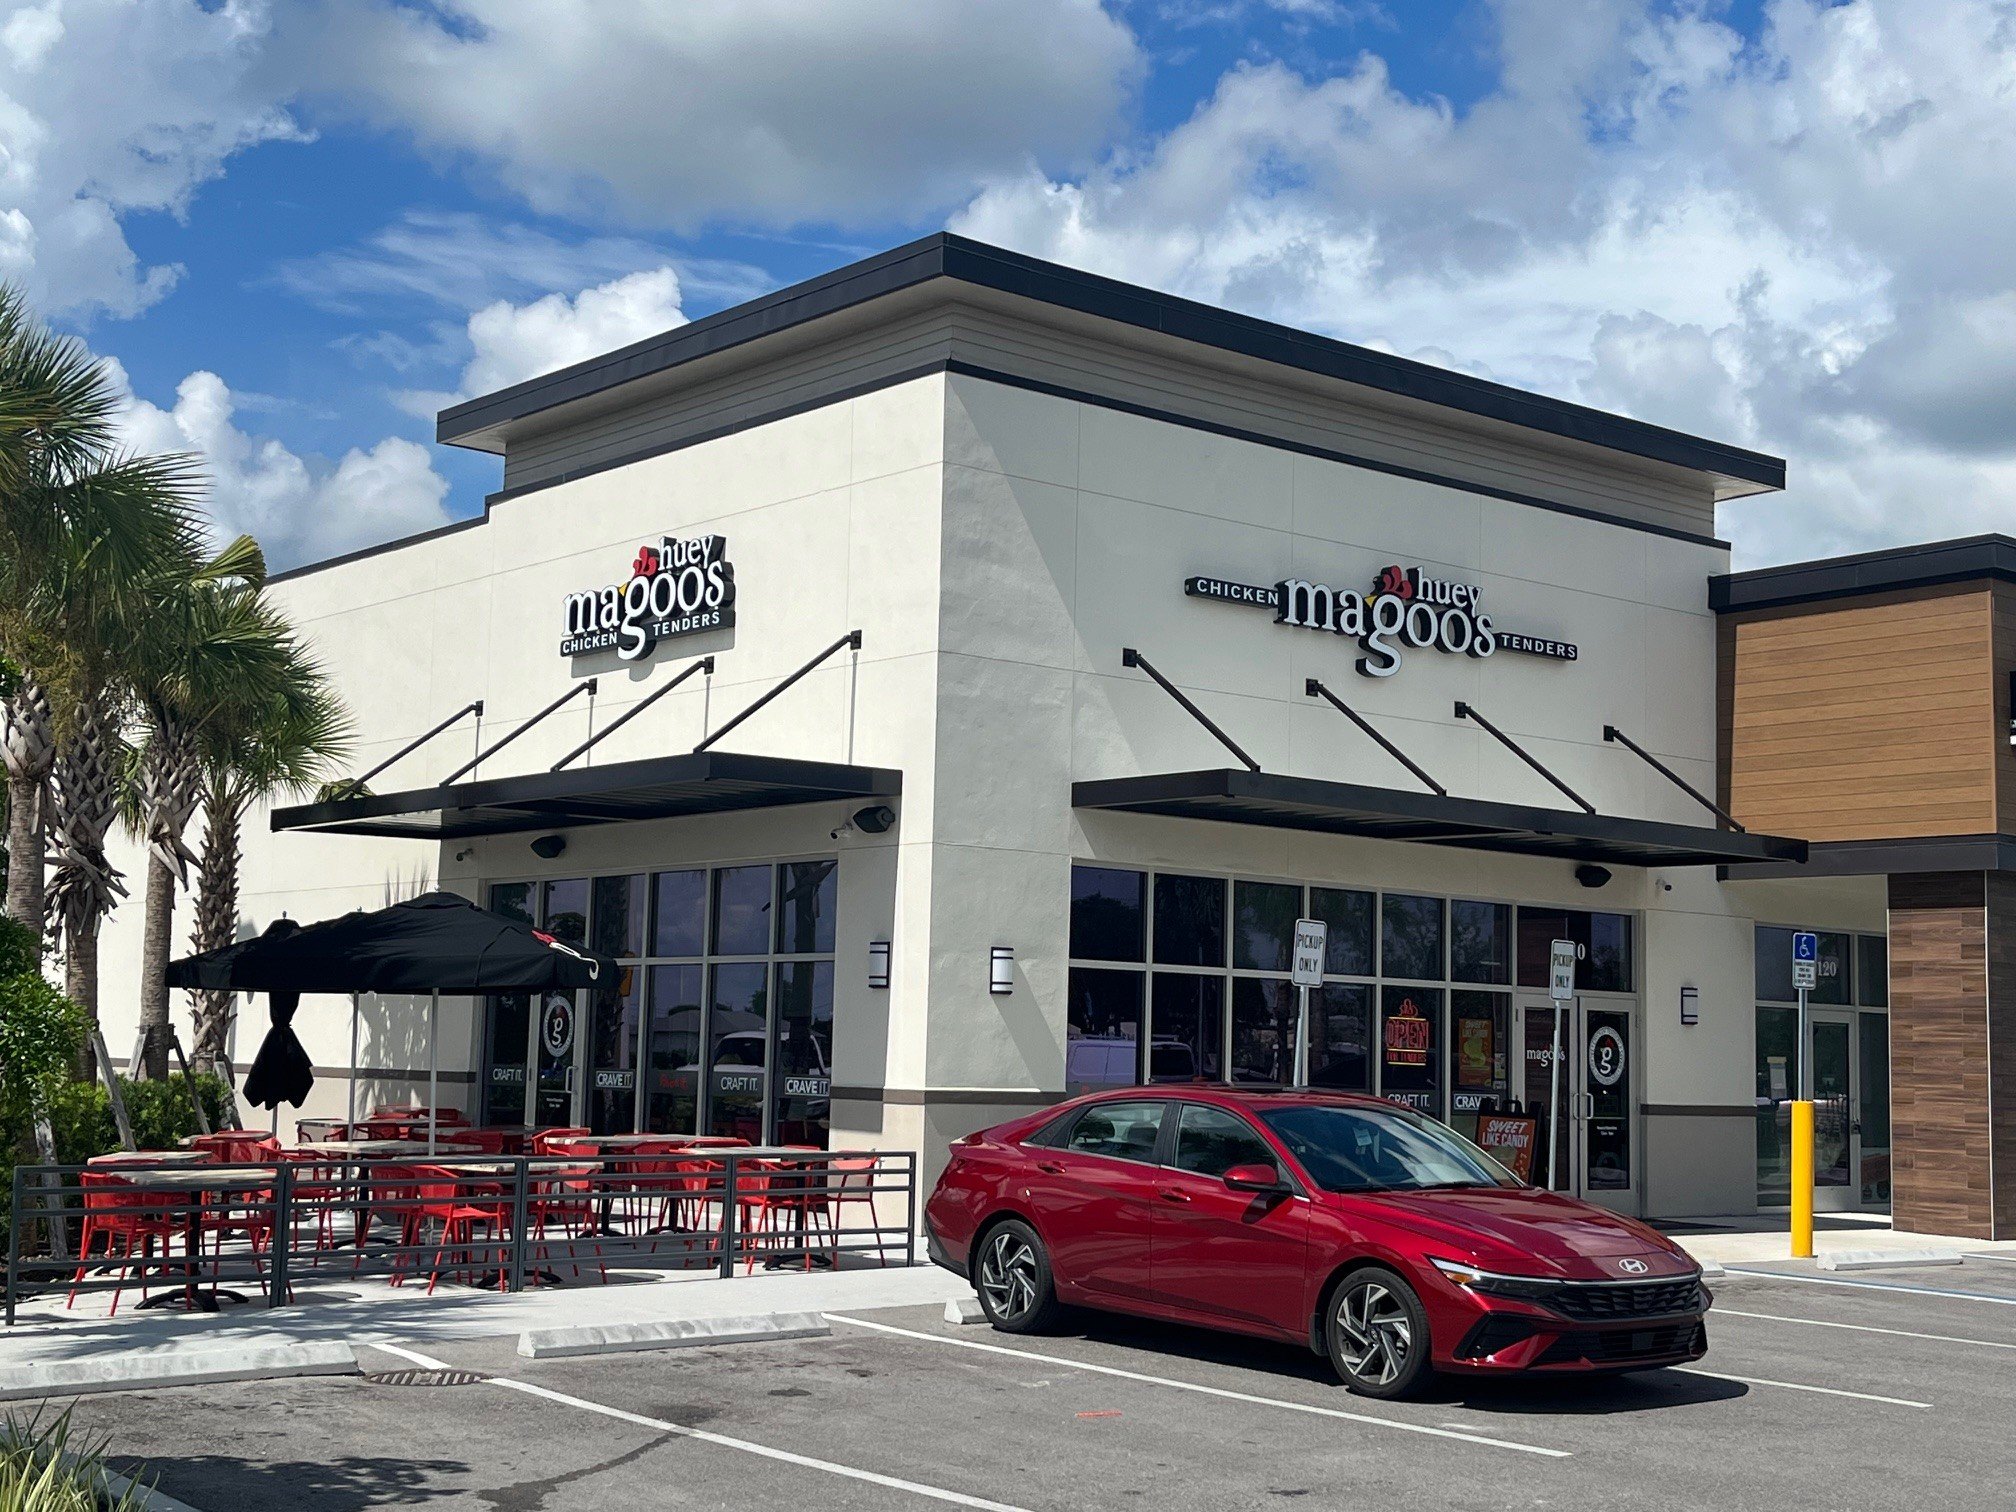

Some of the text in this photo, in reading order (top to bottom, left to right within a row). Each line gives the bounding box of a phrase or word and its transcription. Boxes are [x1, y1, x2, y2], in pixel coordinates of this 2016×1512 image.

[658, 534, 715, 569] huey
[1196, 579, 1279, 605] CHICKEN
[1416, 566, 1483, 618] huey
[653, 611, 721, 636] TENDERS
[563, 632, 618, 654] CHICKEN
[1501, 634, 1576, 659] TENDERS
[1297, 933, 1324, 949] PICKUP
[1299, 957, 1318, 972] ONLY
[1553, 953, 1573, 967] PICKUP
[1818, 961, 1837, 977] 120
[1555, 974, 1570, 988] ONLY
[1386, 1019, 1429, 1049] OPEN
[1526, 1049, 1565, 1067] magos
[492, 1068, 515, 1081] CRAFT
[597, 1073, 623, 1086] CRAVE
[721, 1077, 748, 1091] CRAFT
[786, 1080, 817, 1094] CRAVE
[1456, 1096, 1483, 1108] CRAV
[1487, 1120, 1528, 1134] SWEET
[1482, 1132, 1529, 1148] LIKE CANDY
